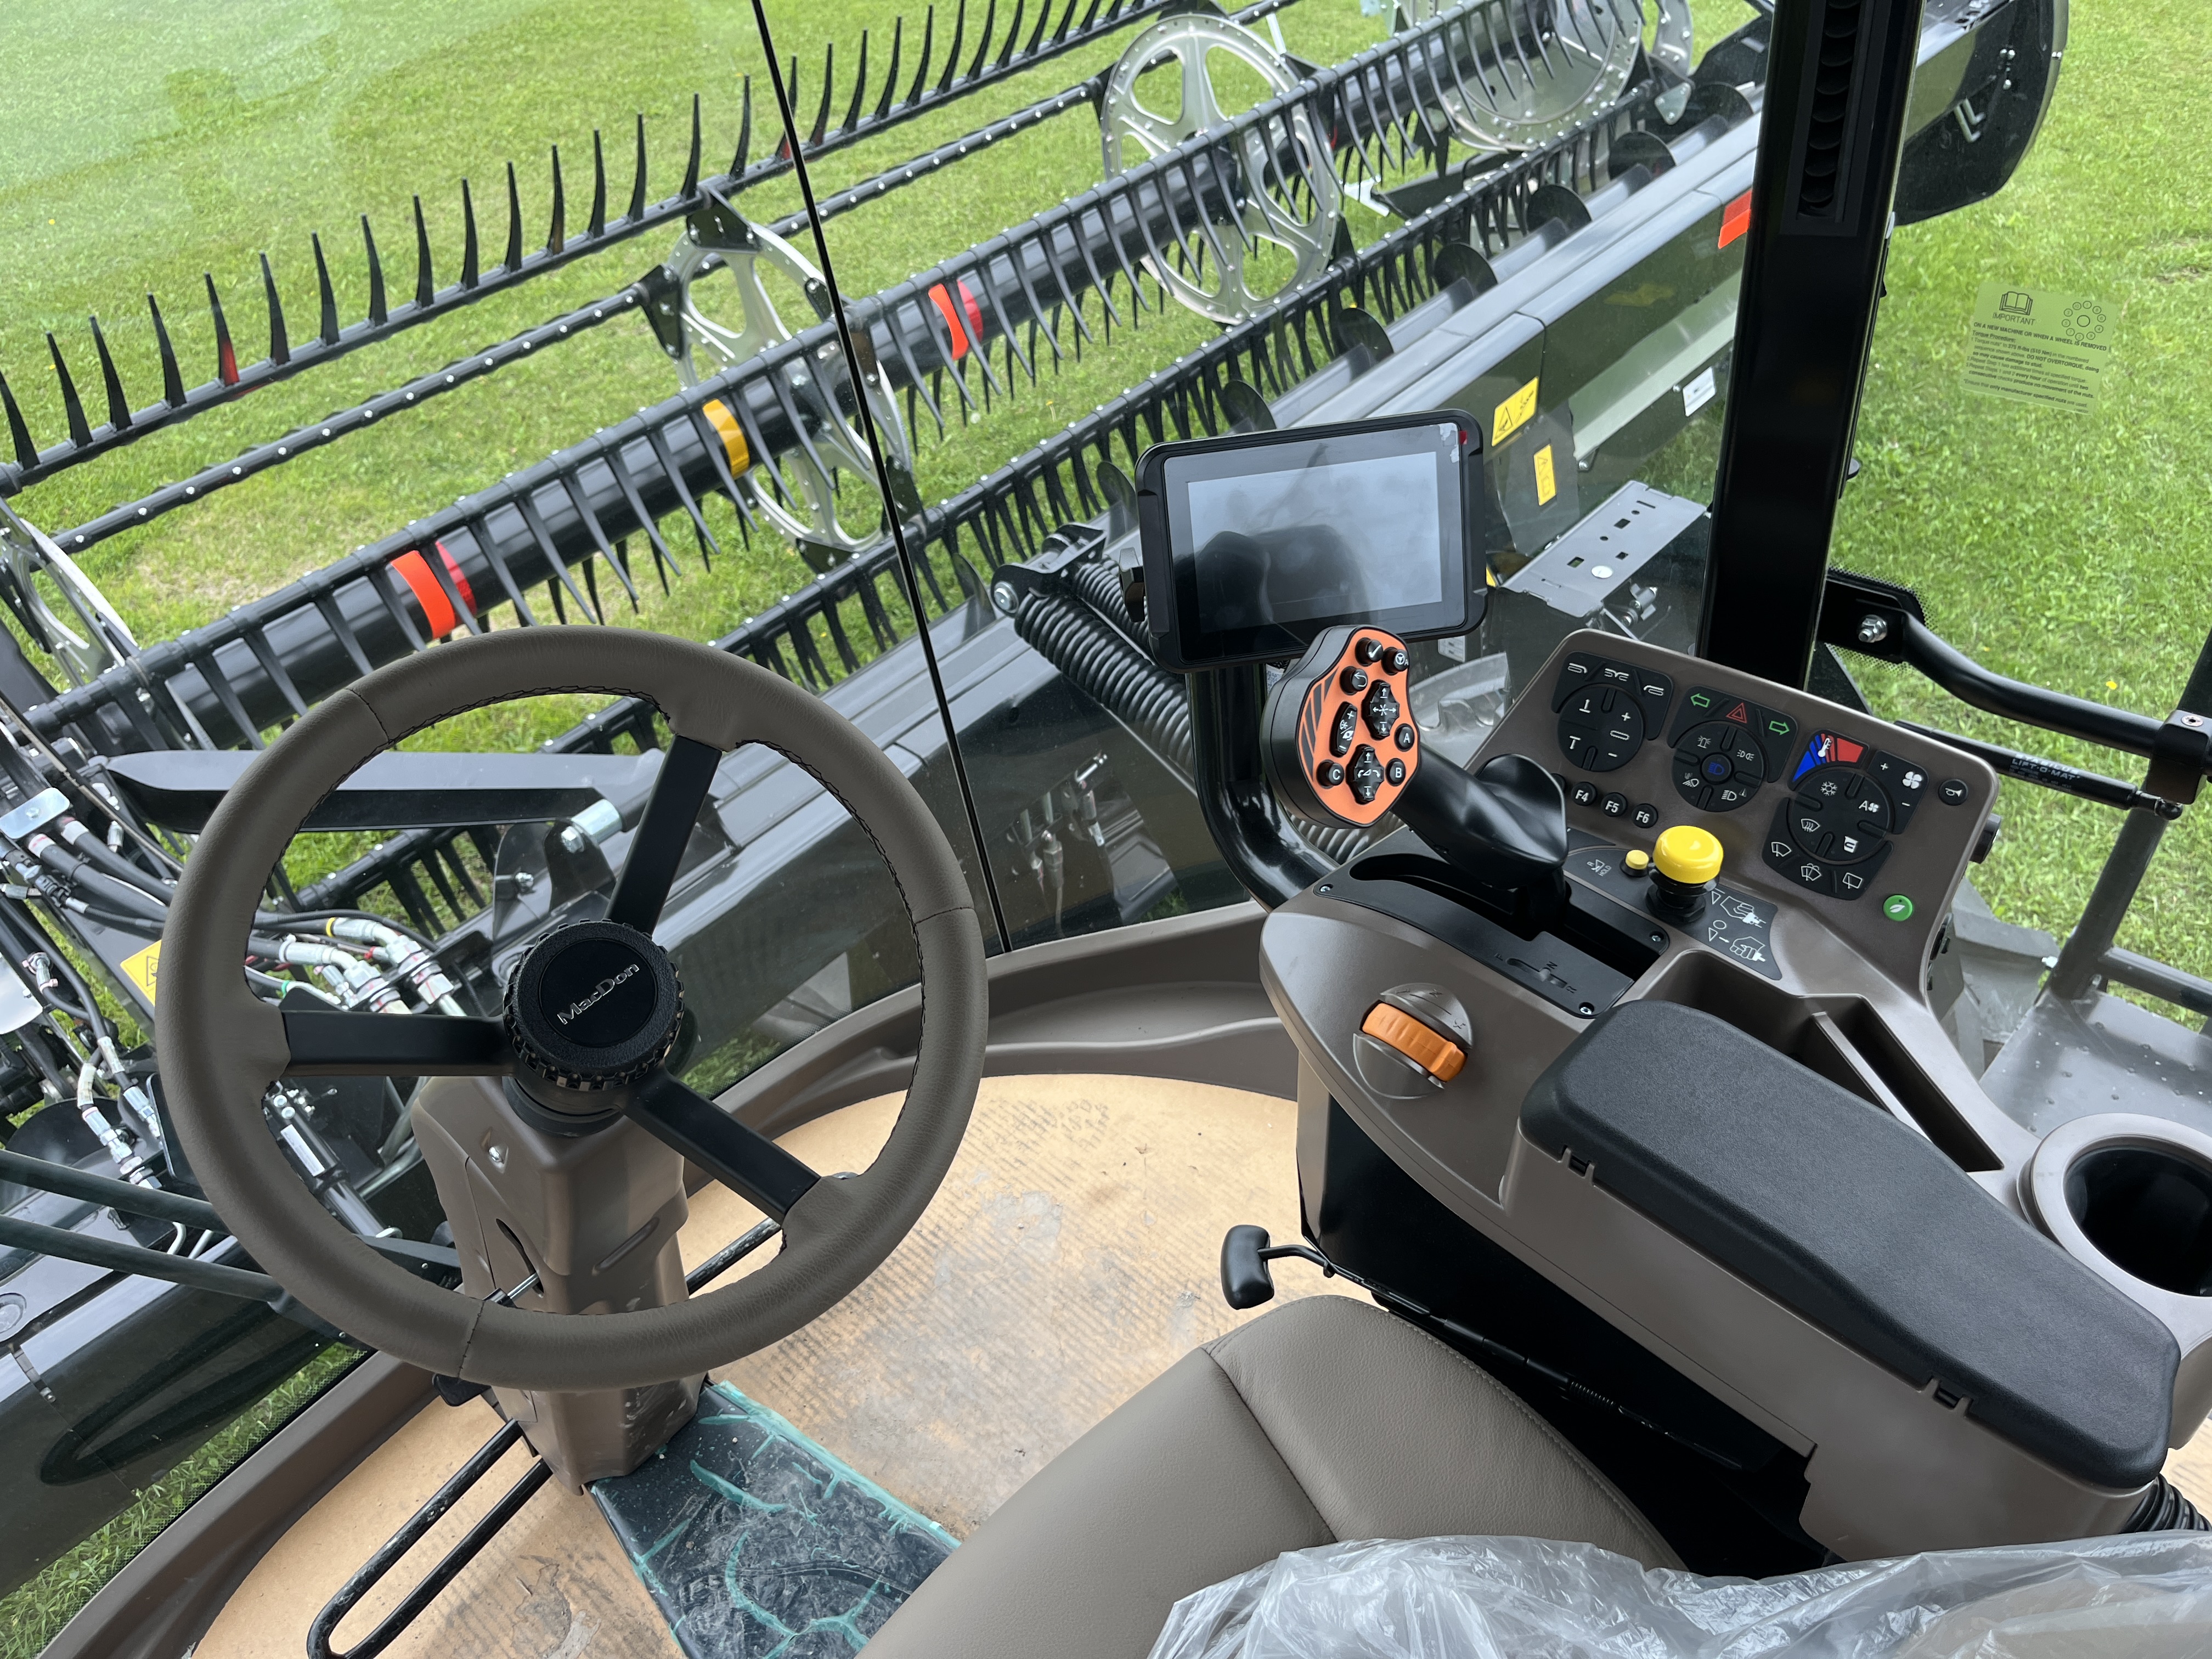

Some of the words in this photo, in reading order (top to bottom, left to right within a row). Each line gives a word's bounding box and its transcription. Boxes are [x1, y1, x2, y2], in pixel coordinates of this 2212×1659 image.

[1993, 312, 2035, 325] IMPORTANT
[2000, 326, 2023, 335] MACHINE
[2081, 341, 2107, 350] REMOVED
[2001, 387, 2032, 396] manufacturer
[2033, 393, 2055, 402] specified
[1403, 732, 1410, 743] A
[1332, 769, 1340, 780] C
[1395, 767, 1402, 778] B
[1575, 789, 1590, 803] F4
[1605, 800, 1621, 814] F5
[1859, 800, 1868, 811] A
[1635, 810, 1651, 824] F6
[1598, 865, 1612, 877] HOLD
[556, 963, 640, 1025] MacDon
